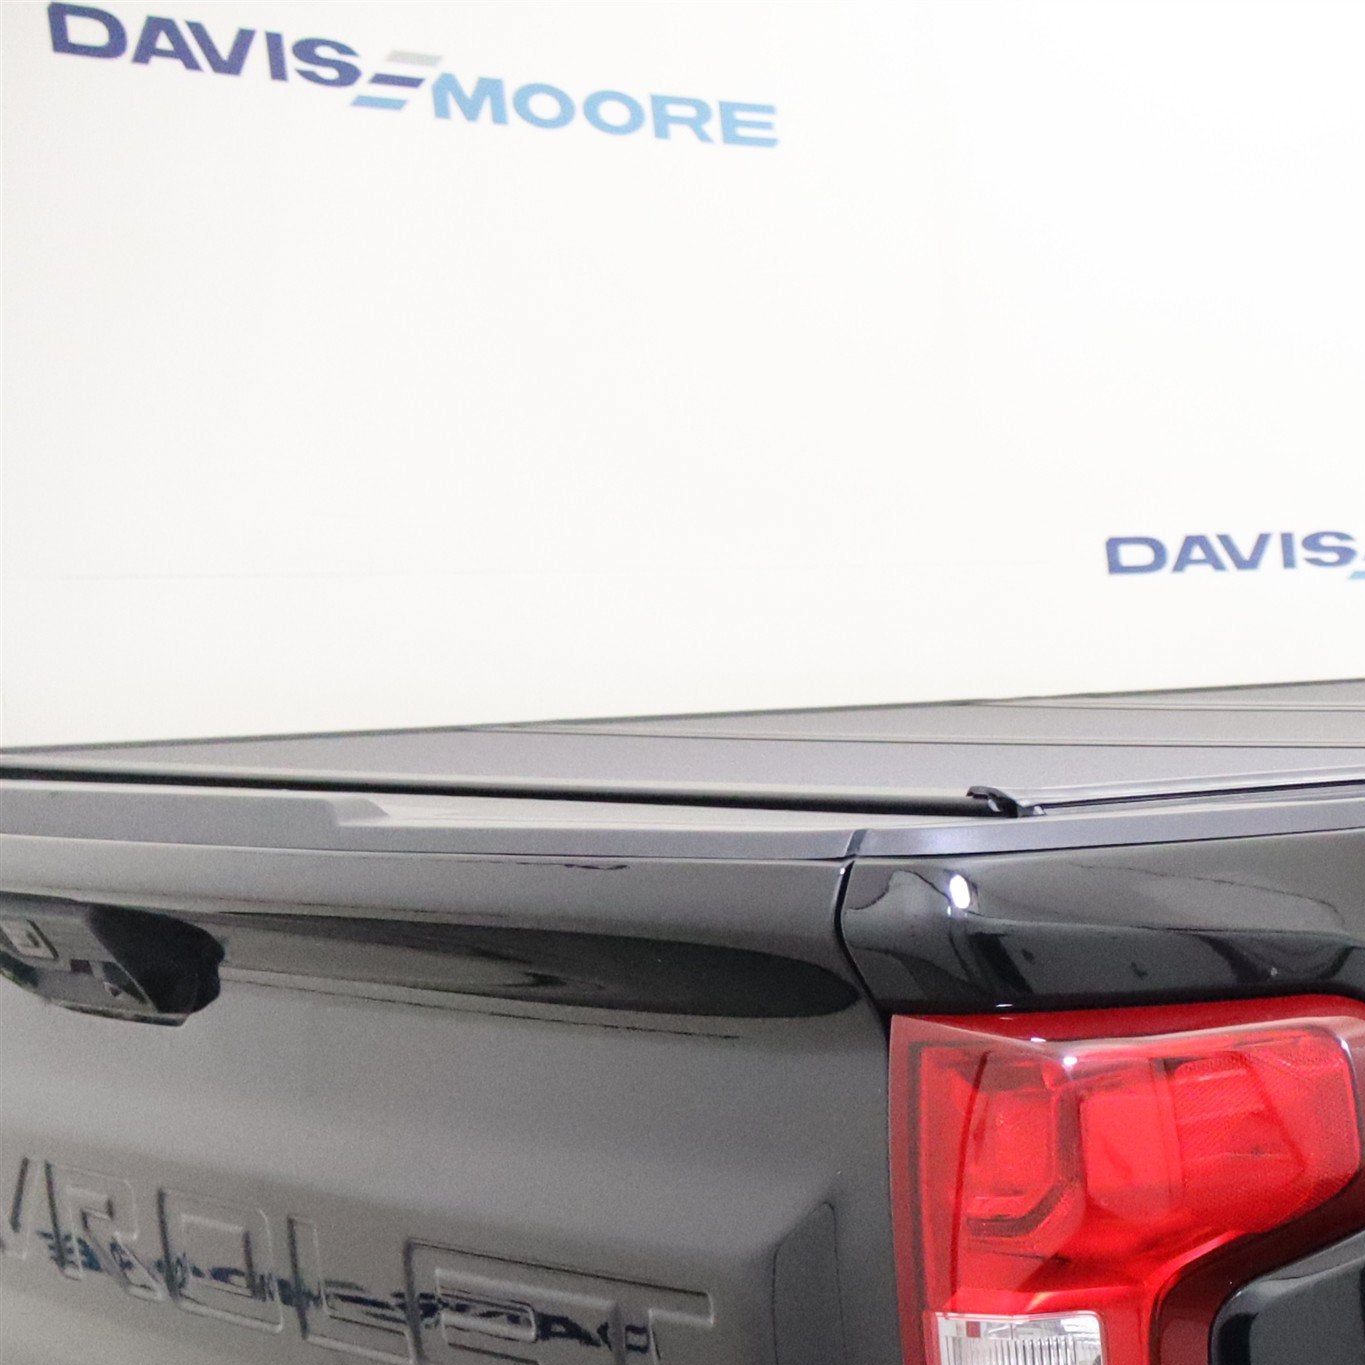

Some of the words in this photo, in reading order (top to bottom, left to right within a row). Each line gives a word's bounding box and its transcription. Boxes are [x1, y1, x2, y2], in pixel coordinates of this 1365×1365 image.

[46, 1, 362, 88] DAVIS
[432, 72, 778, 148] MOORE
[1105, 531, 1356, 575] DAVIS
